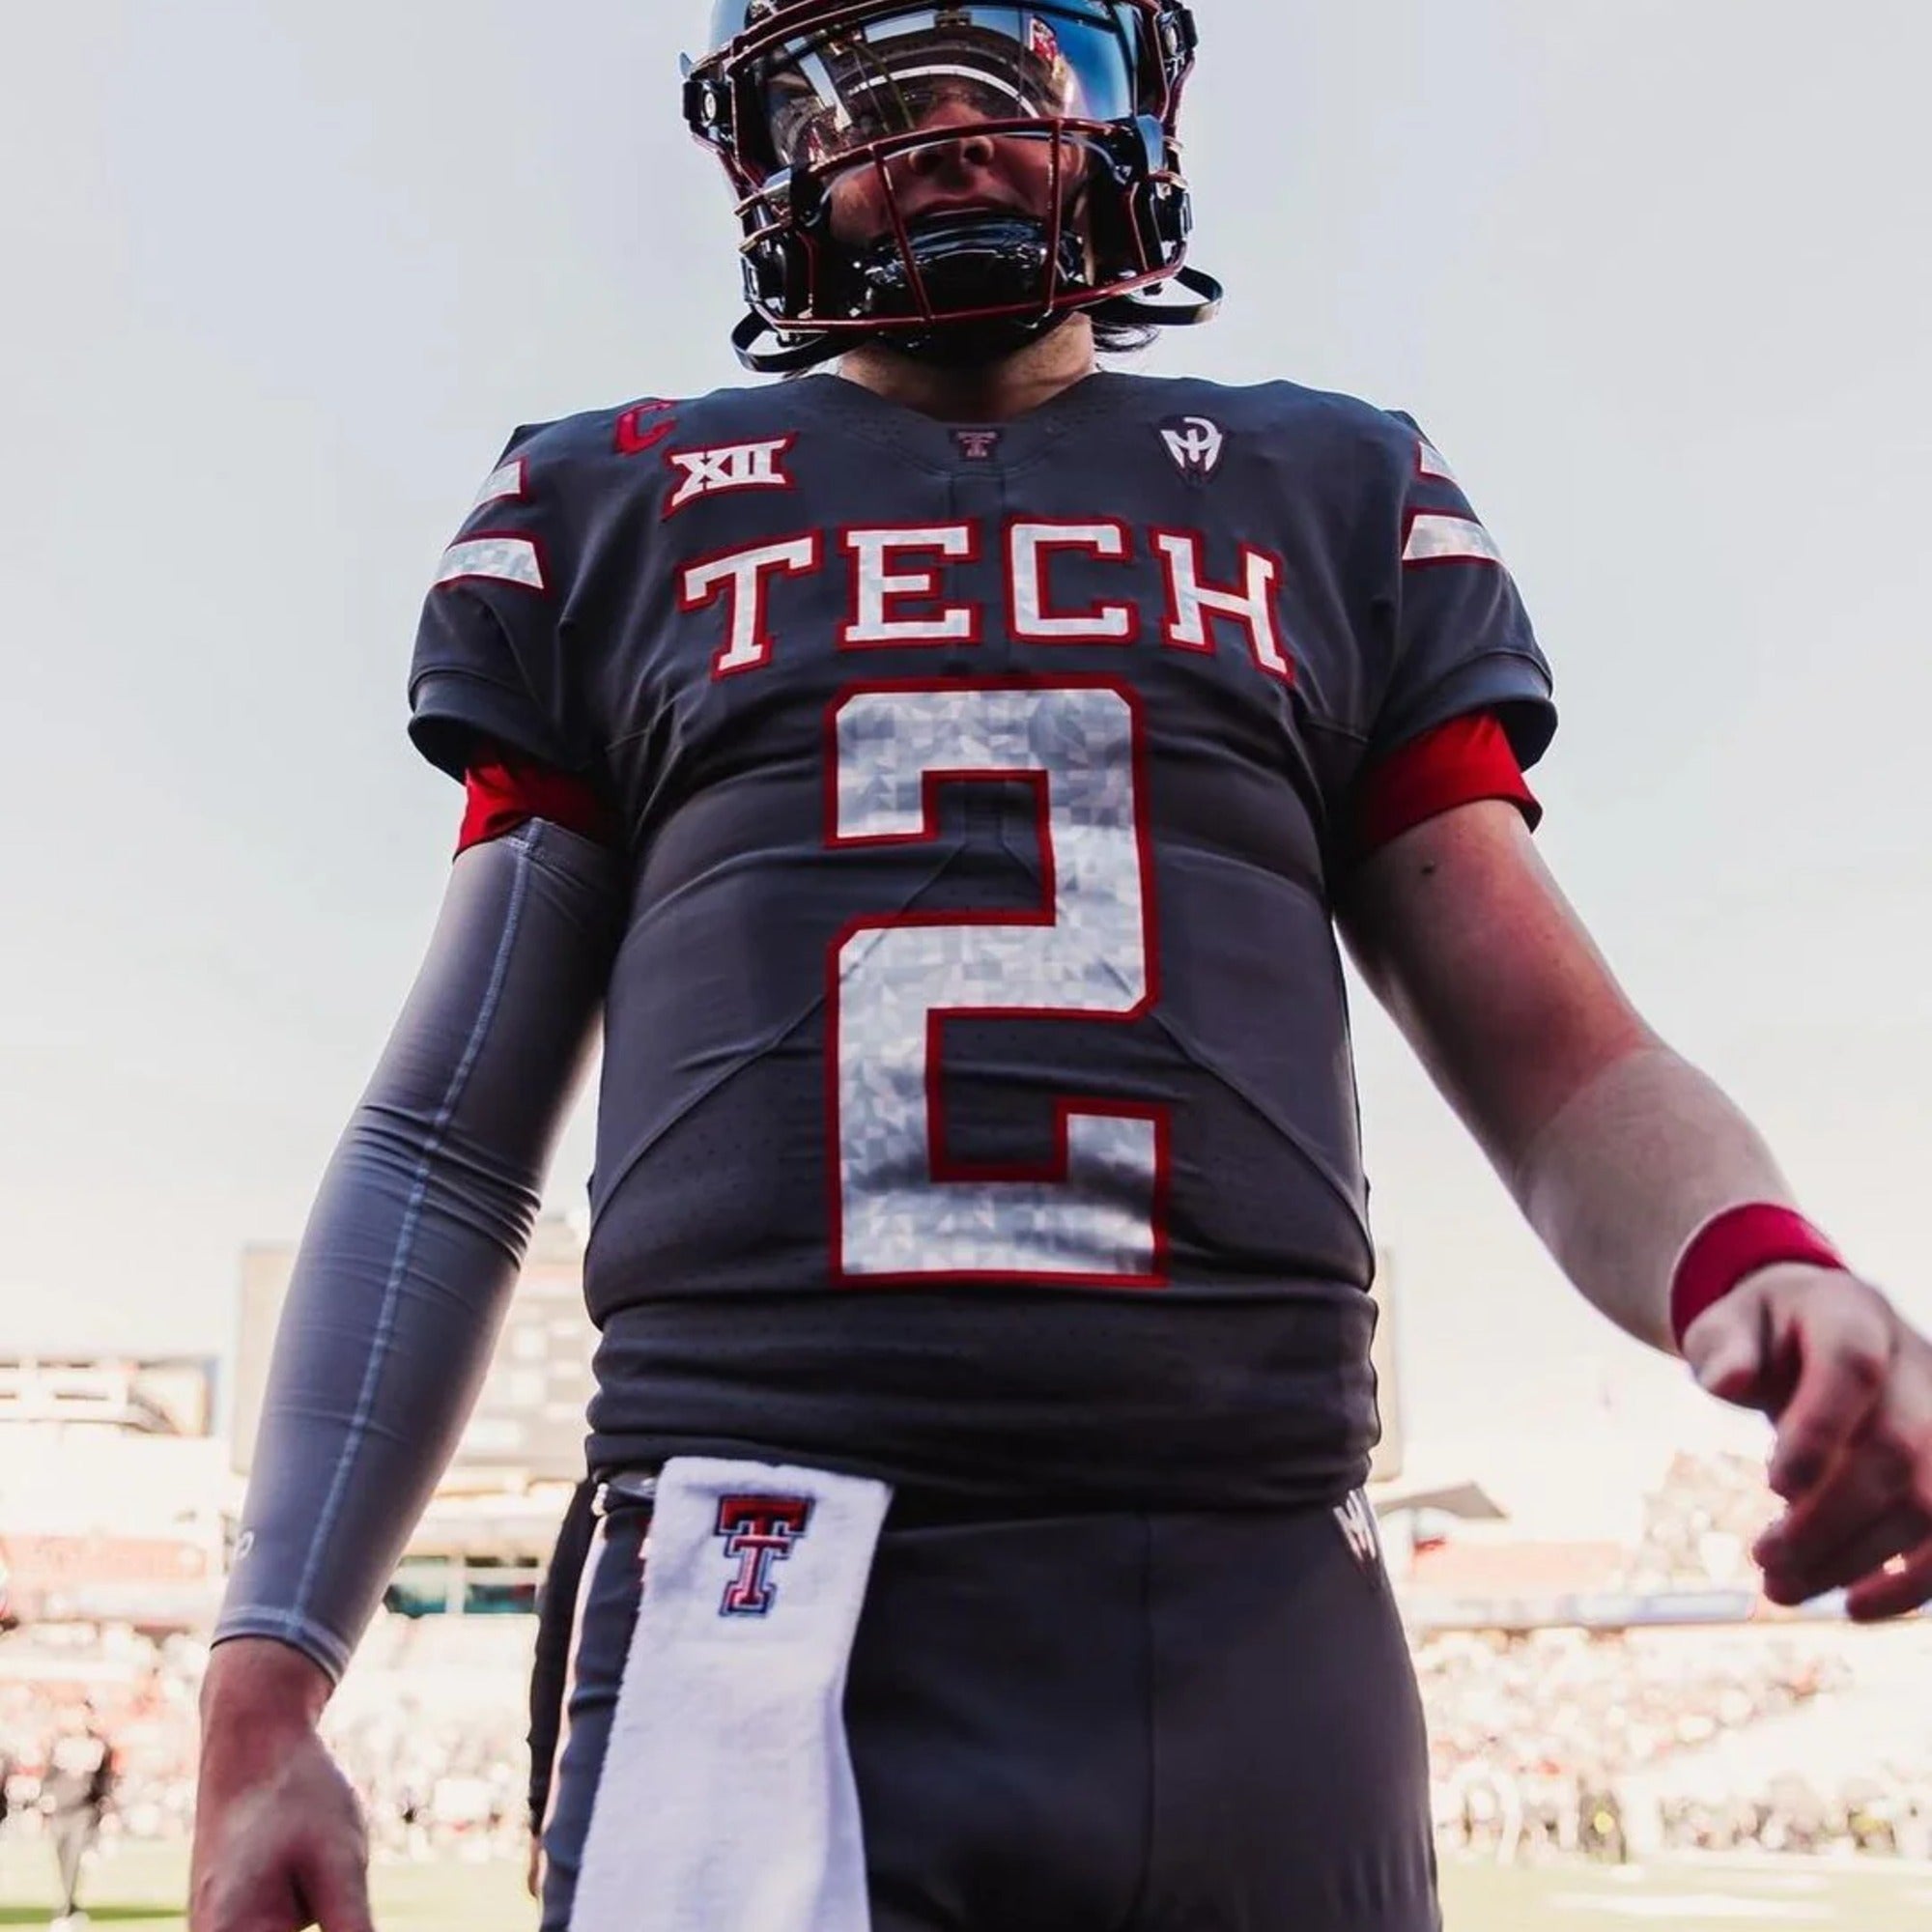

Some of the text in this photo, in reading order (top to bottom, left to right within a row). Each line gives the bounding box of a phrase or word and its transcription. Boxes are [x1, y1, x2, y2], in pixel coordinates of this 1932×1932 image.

[613, 401, 678, 456] C
[667, 437, 791, 511] XII
[681, 519, 1293, 678] TECH
[829, 678, 1165, 1283] 2
